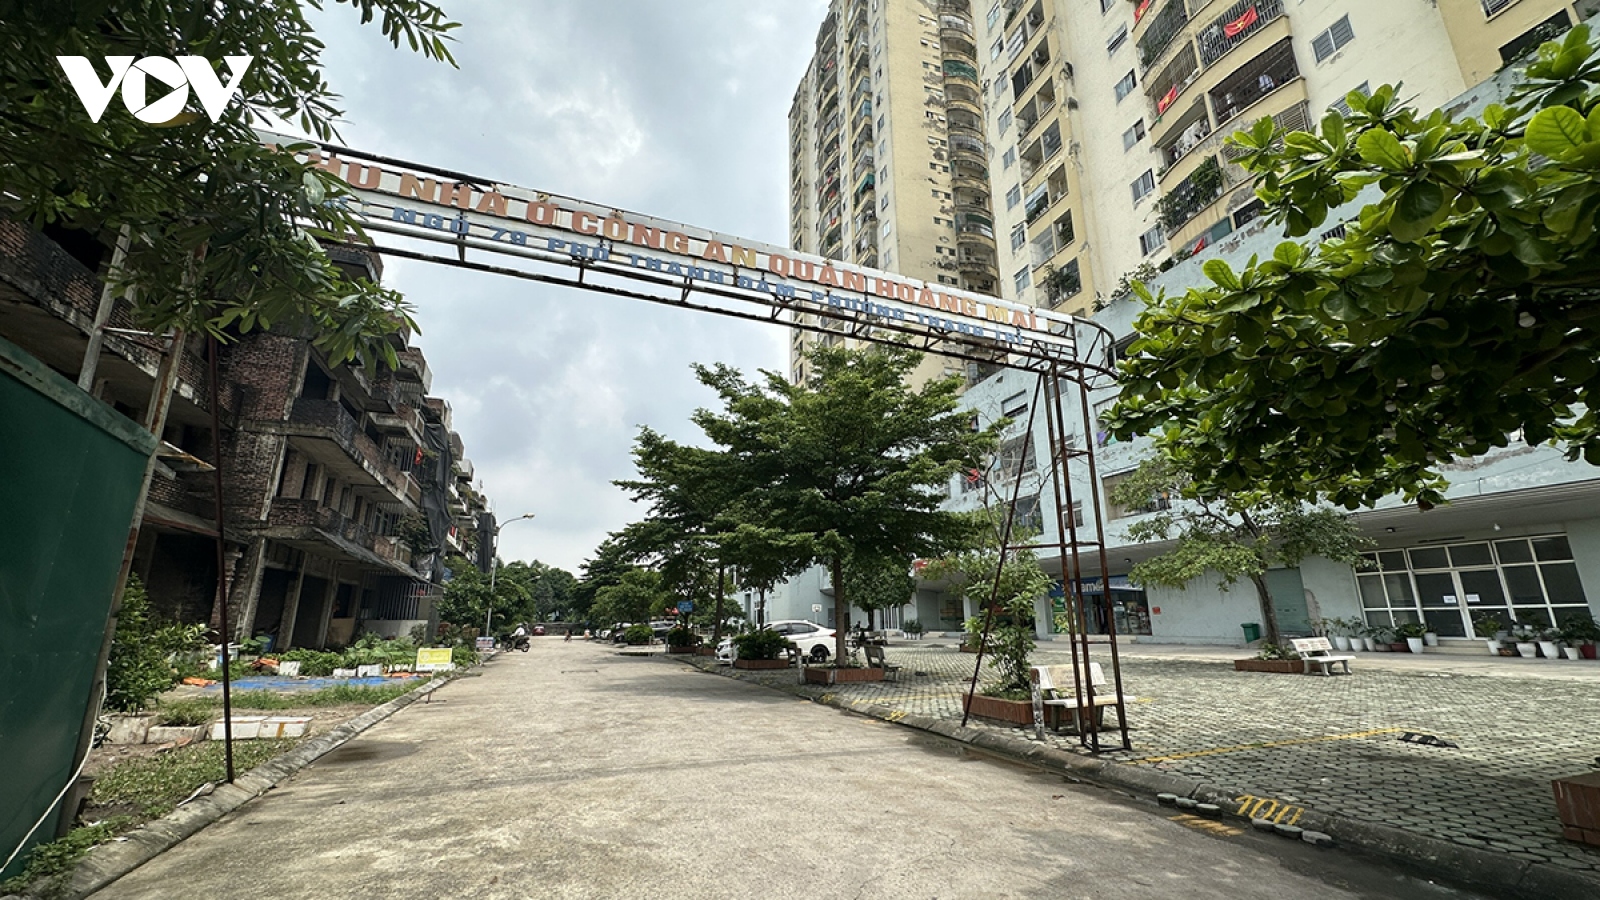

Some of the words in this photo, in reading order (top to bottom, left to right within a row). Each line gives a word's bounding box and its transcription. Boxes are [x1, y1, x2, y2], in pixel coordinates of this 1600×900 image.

[489, 225, 526, 245] 79
[628, 253, 724, 284] THANH
[916, 312, 984, 336] THANH
[572, 208, 688, 255] CÔNG
[703, 240, 756, 268] AN
[769, 254, 864, 292] QUẬN
[876, 277, 976, 316] HOÀNG
[1235, 794, 1305, 826] 100
